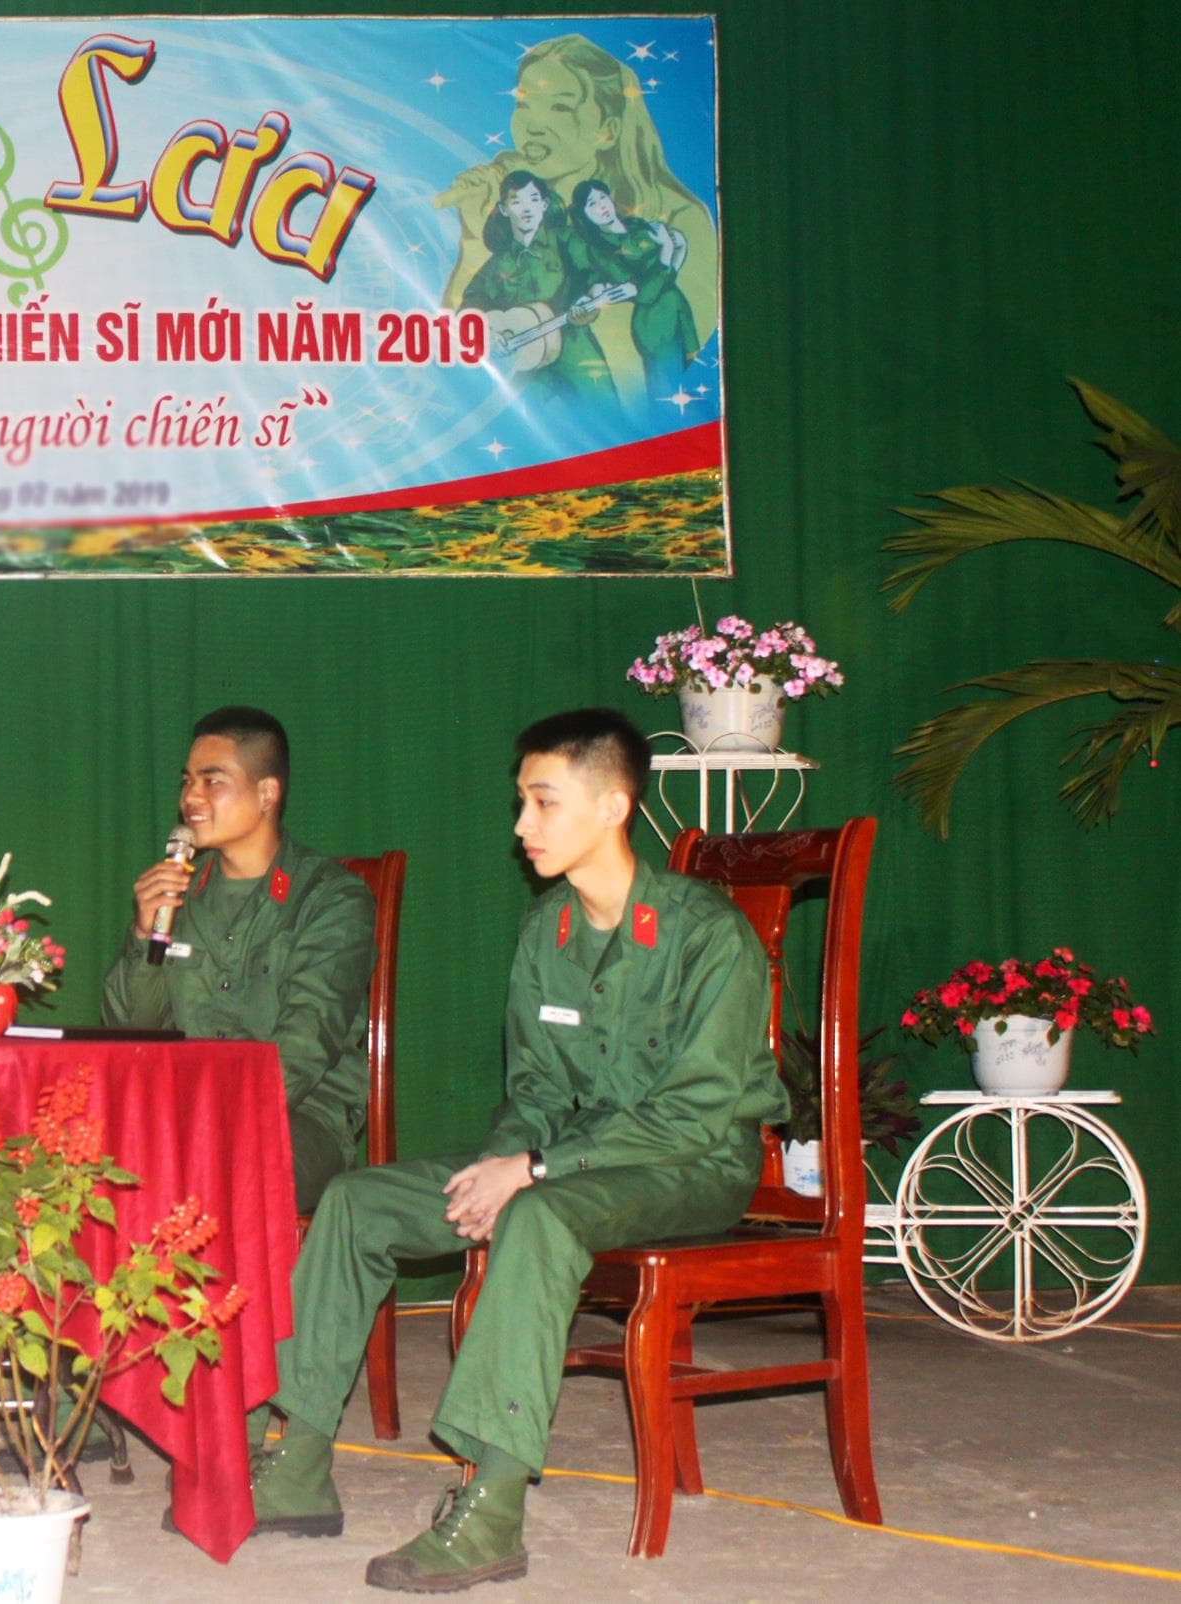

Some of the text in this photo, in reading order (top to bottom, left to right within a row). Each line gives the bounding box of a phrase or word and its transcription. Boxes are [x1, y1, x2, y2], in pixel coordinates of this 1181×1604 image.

[44, 33, 376, 281] Lưu
[97, 303, 140, 363] SĨ
[157, 297, 242, 363] MỚI
[259, 302, 362, 363] NĂM
[378, 313, 484, 364] 2019
[125, 395, 240, 447] chiến
